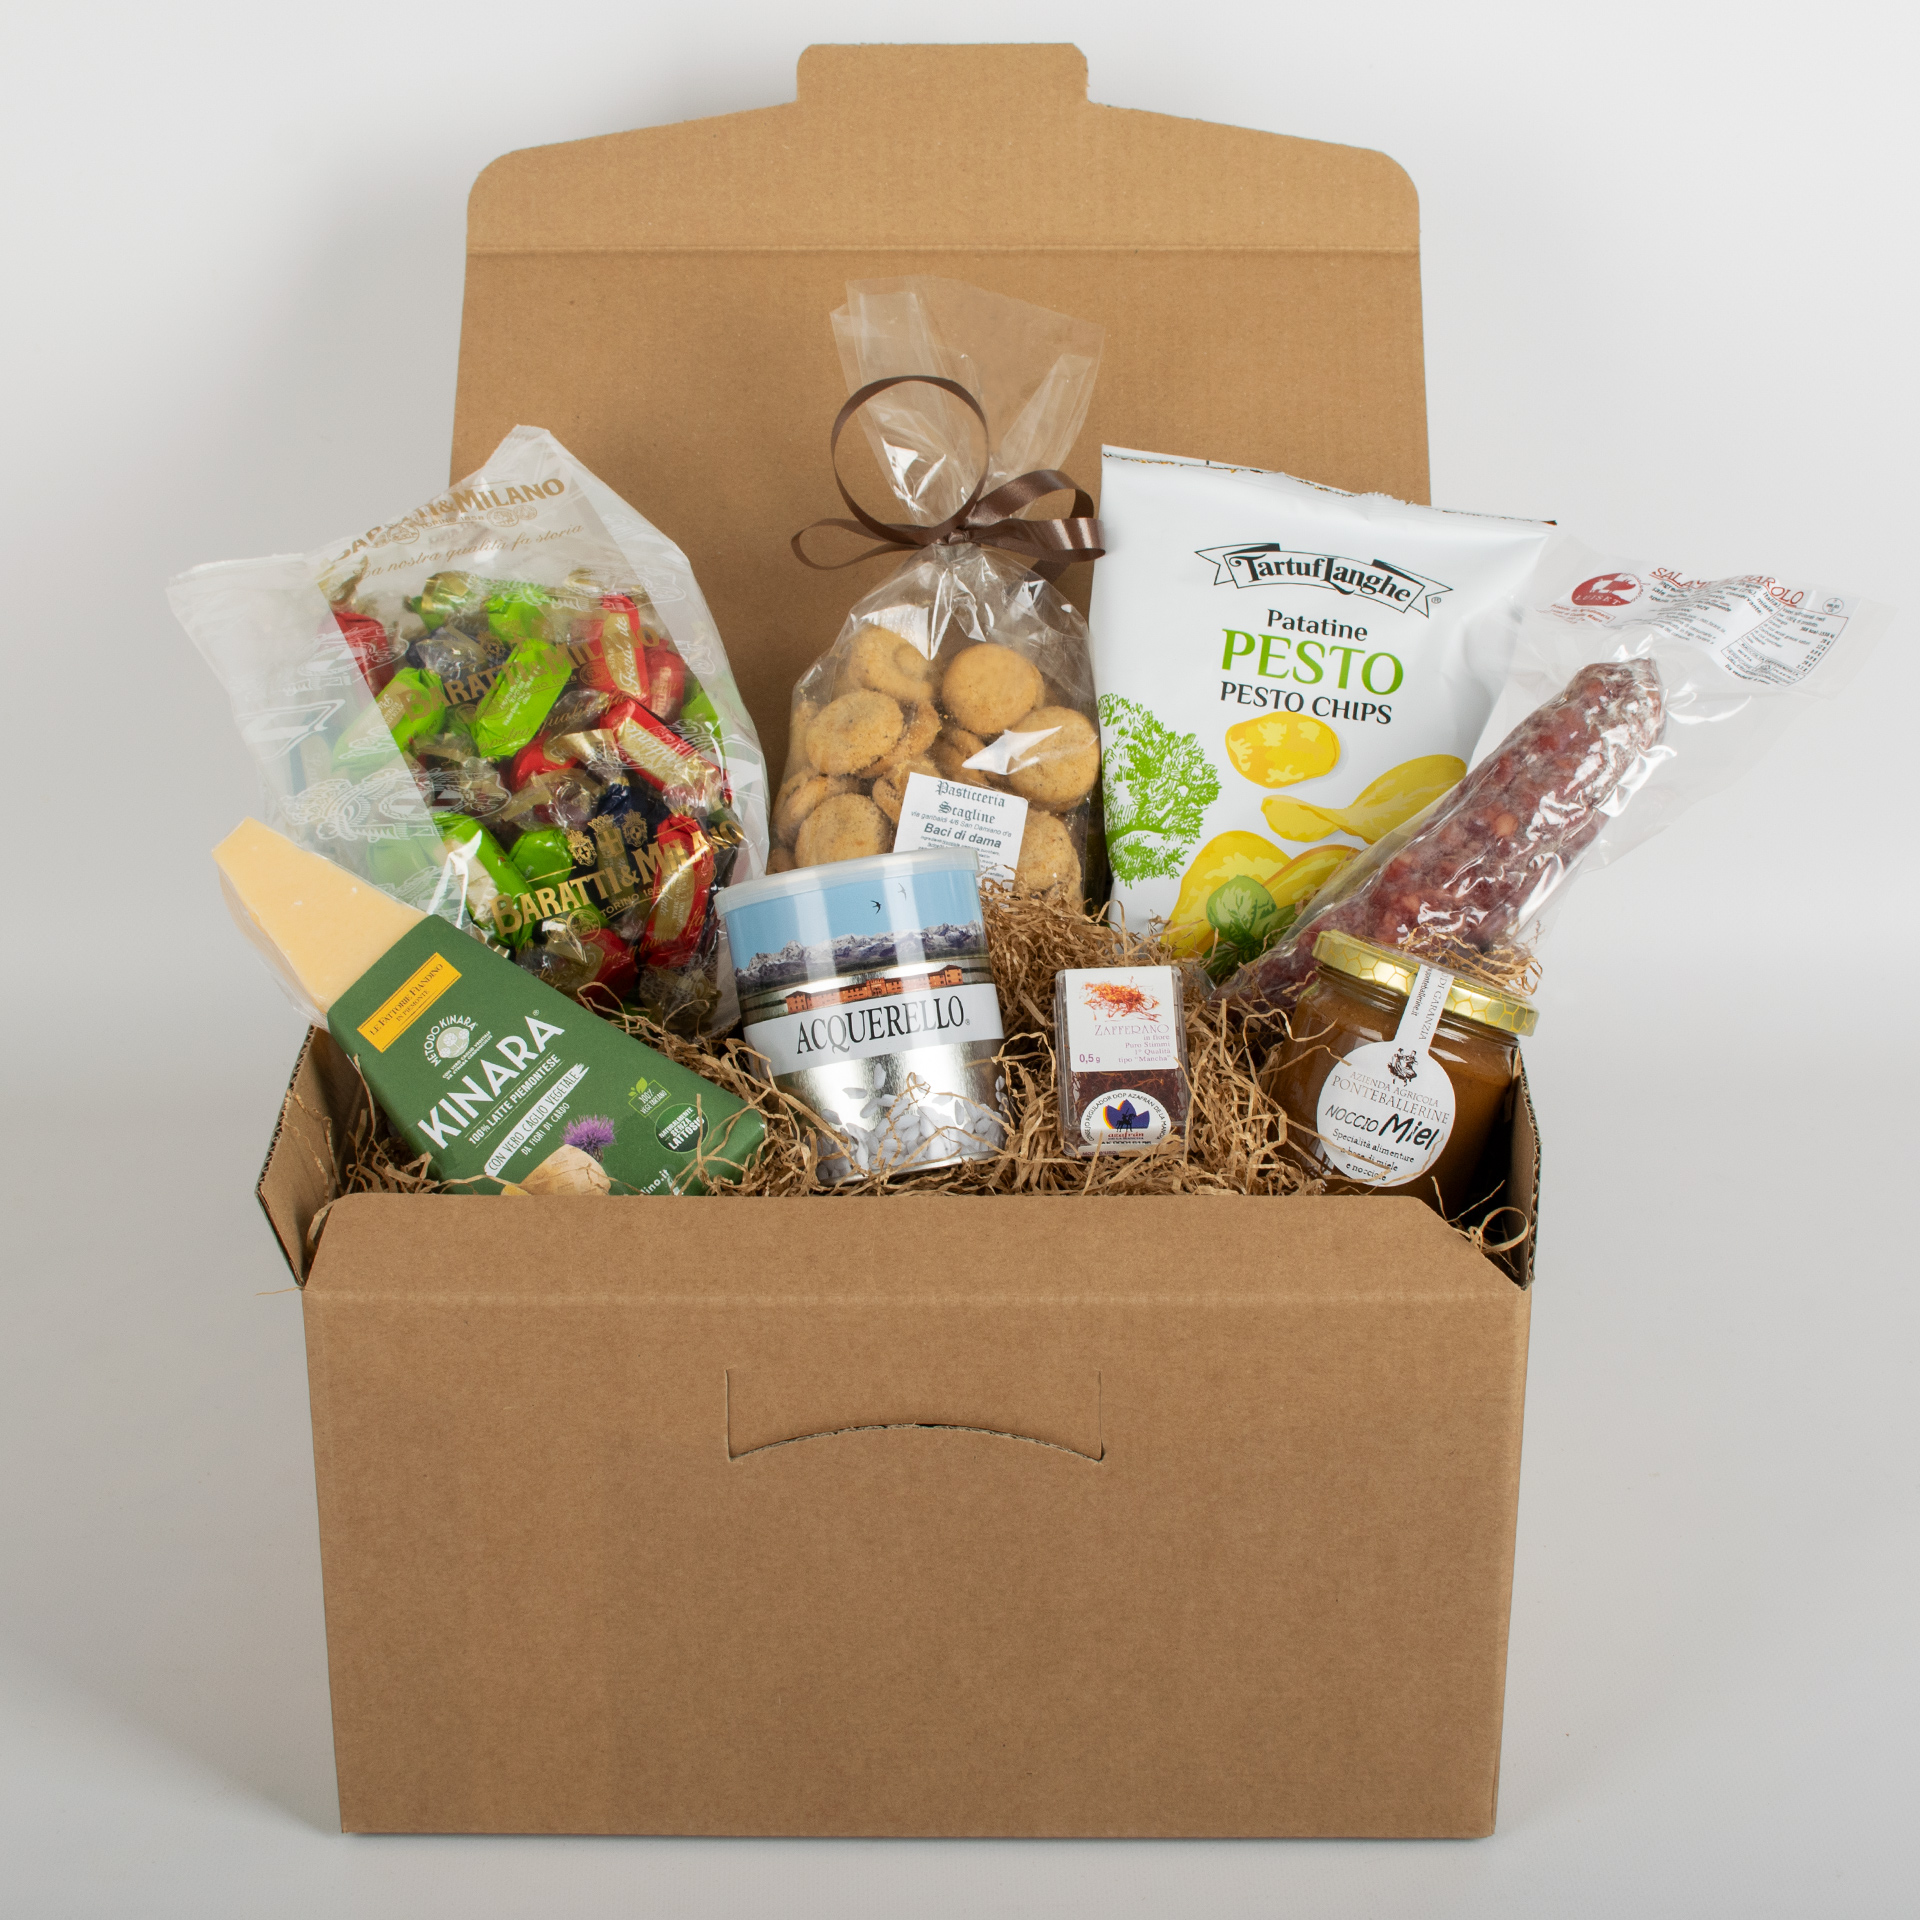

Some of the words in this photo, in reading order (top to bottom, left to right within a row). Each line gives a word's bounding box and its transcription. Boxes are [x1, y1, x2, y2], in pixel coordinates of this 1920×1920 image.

[388, 548, 441, 573] nostra
[446, 536, 507, 561] qualità
[508, 532, 531, 552] fa
[535, 524, 584, 543] storia
[1651, 567, 1707, 589] SALA
[1574, 593, 1621, 606] LUISET
[1267, 608, 1368, 642] Patatine
[1221, 628, 1404, 696] PESTO
[1220, 680, 1304, 713] PESTO
[1312, 695, 1392, 725] CHIPS
[935, 780, 1006, 807] Pasticceria
[921, 812, 948, 824] garibaldi
[960, 820, 973, 829] San
[974, 823, 1001, 835] Damiano
[938, 800, 996, 825] Scagline
[924, 822, 952, 838] Baci
[954, 830, 967, 841] di
[968, 833, 1002, 848] dama
[600, 893, 640, 917] TORINO
[369, 1025, 380, 1036] LE
[378, 995, 412, 1026] FATTORIE
[409, 963, 444, 997] FIANDINO
[1418, 991, 1442, 1040] GARANZIA
[424, 1025, 441, 1067] METODO
[439, 1015, 477, 1031] KINARA
[797, 995, 964, 1054] ACQUERELLO
[1094, 1023, 1170, 1037] ZAFFERANO
[1079, 1053, 1094, 1064] 0,5
[1095, 1056, 1101, 1064] g
[1144, 1048, 1171, 1056] Qualità
[417, 1015, 565, 1150] KINARA
[468, 1124, 491, 1145] 100%
[487, 1101, 514, 1127] LATTE
[510, 1053, 561, 1104] PIEMONTESE
[638, 1088, 655, 1104] 100%
[1350, 1071, 1391, 1092] AZIENDA
[1393, 1086, 1439, 1108] AGRICOLA
[1086, 1096, 1112, 1122] REGULADOR
[1112, 1092, 1127, 1100] DOP
[1332, 1075, 1450, 1125] PONTEBALLERINE
[488, 1152, 507, 1171] CON
[502, 1131, 525, 1153] VERO
[521, 1105, 549, 1132] CAGLIO
[545, 1071, 580, 1105] VEGETALE
[520, 1144, 532, 1156] DA
[529, 1129, 547, 1146] FIORI
[544, 1122, 553, 1132] DI
[552, 1102, 571, 1123] CARDO
[658, 1106, 695, 1139] NATURALMENTE
[670, 1117, 692, 1137] SENZA
[1325, 1104, 1379, 1132] NOCCIO
[1378, 1113, 1440, 1151] Miel
[1332, 1128, 1371, 1149] Specialità
